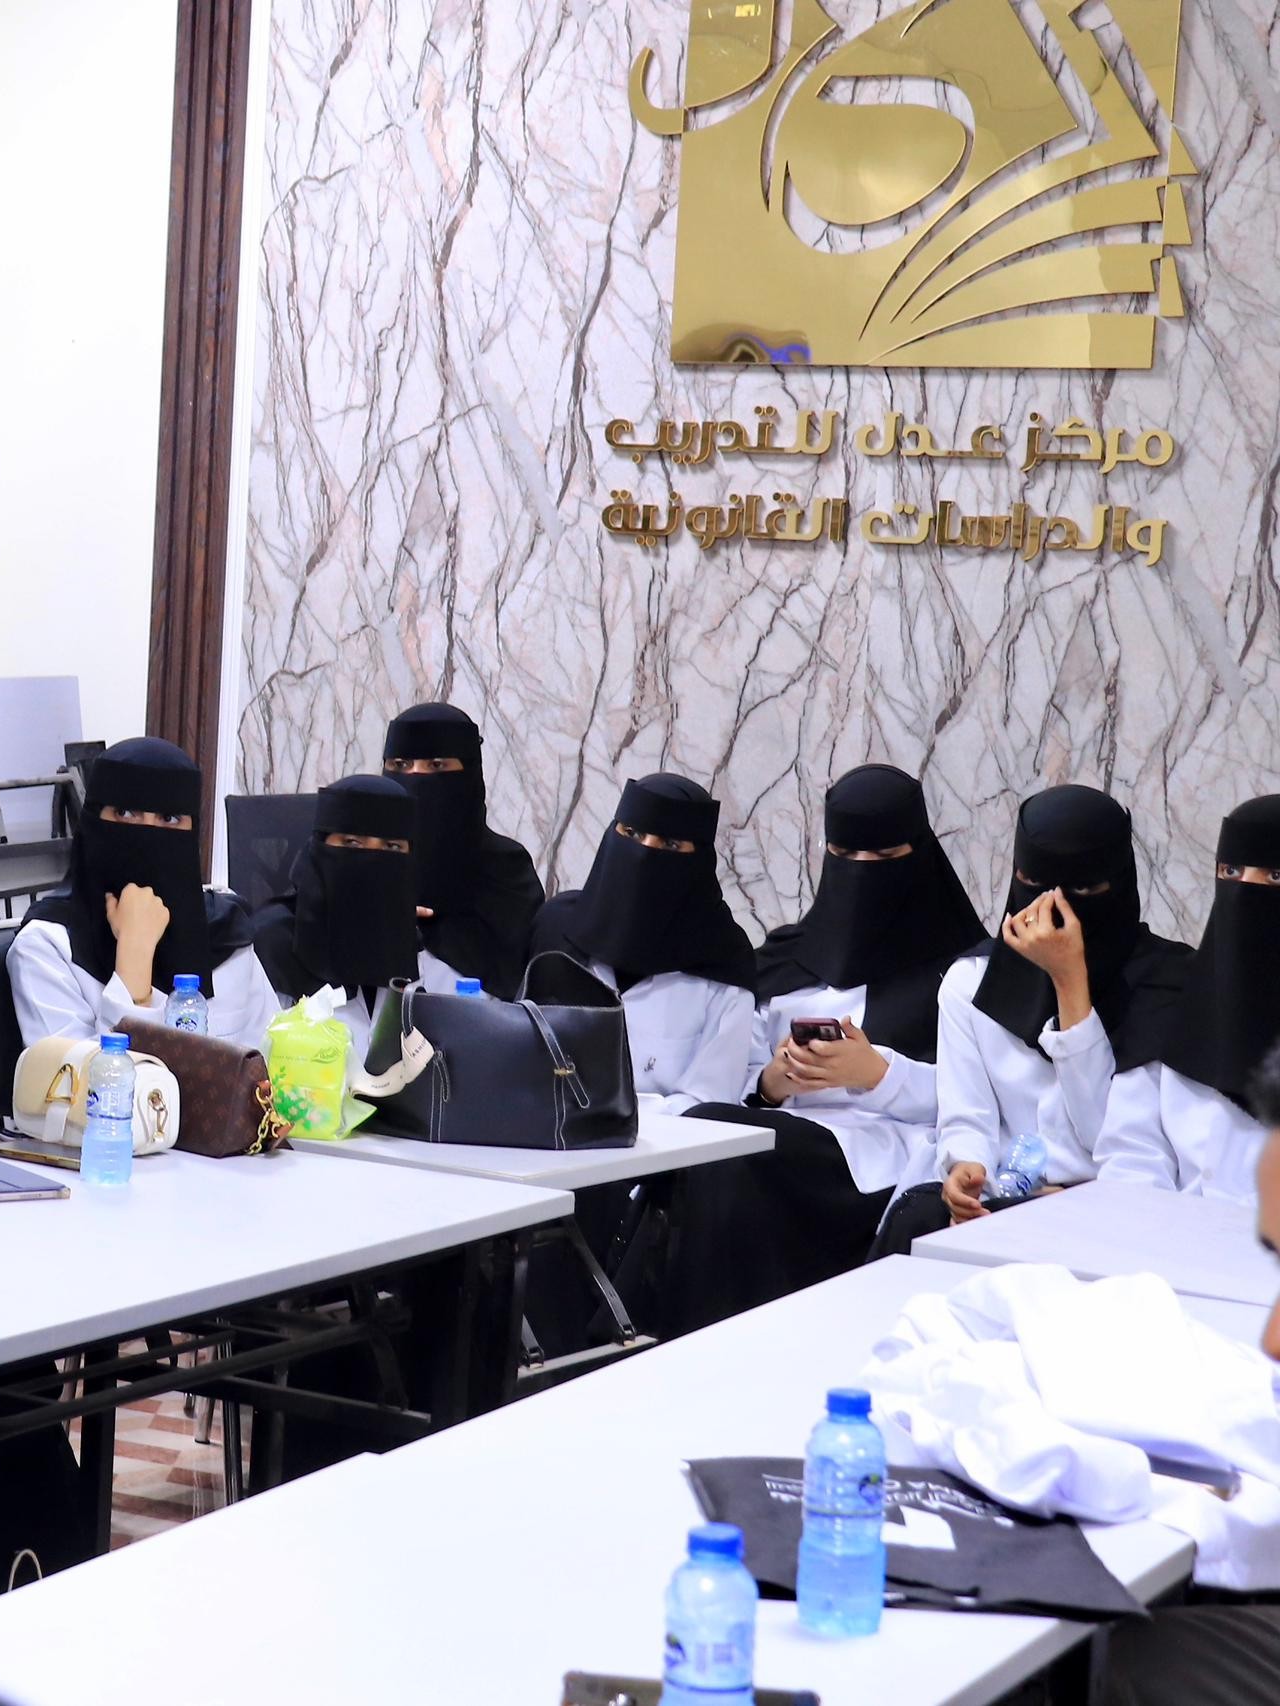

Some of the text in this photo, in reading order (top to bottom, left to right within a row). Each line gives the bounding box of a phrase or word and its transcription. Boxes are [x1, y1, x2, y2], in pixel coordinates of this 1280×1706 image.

[604, 405, 1175, 475] مركز عدل للتدريب
[601, 489, 1169, 567] والدراسات القانونية
